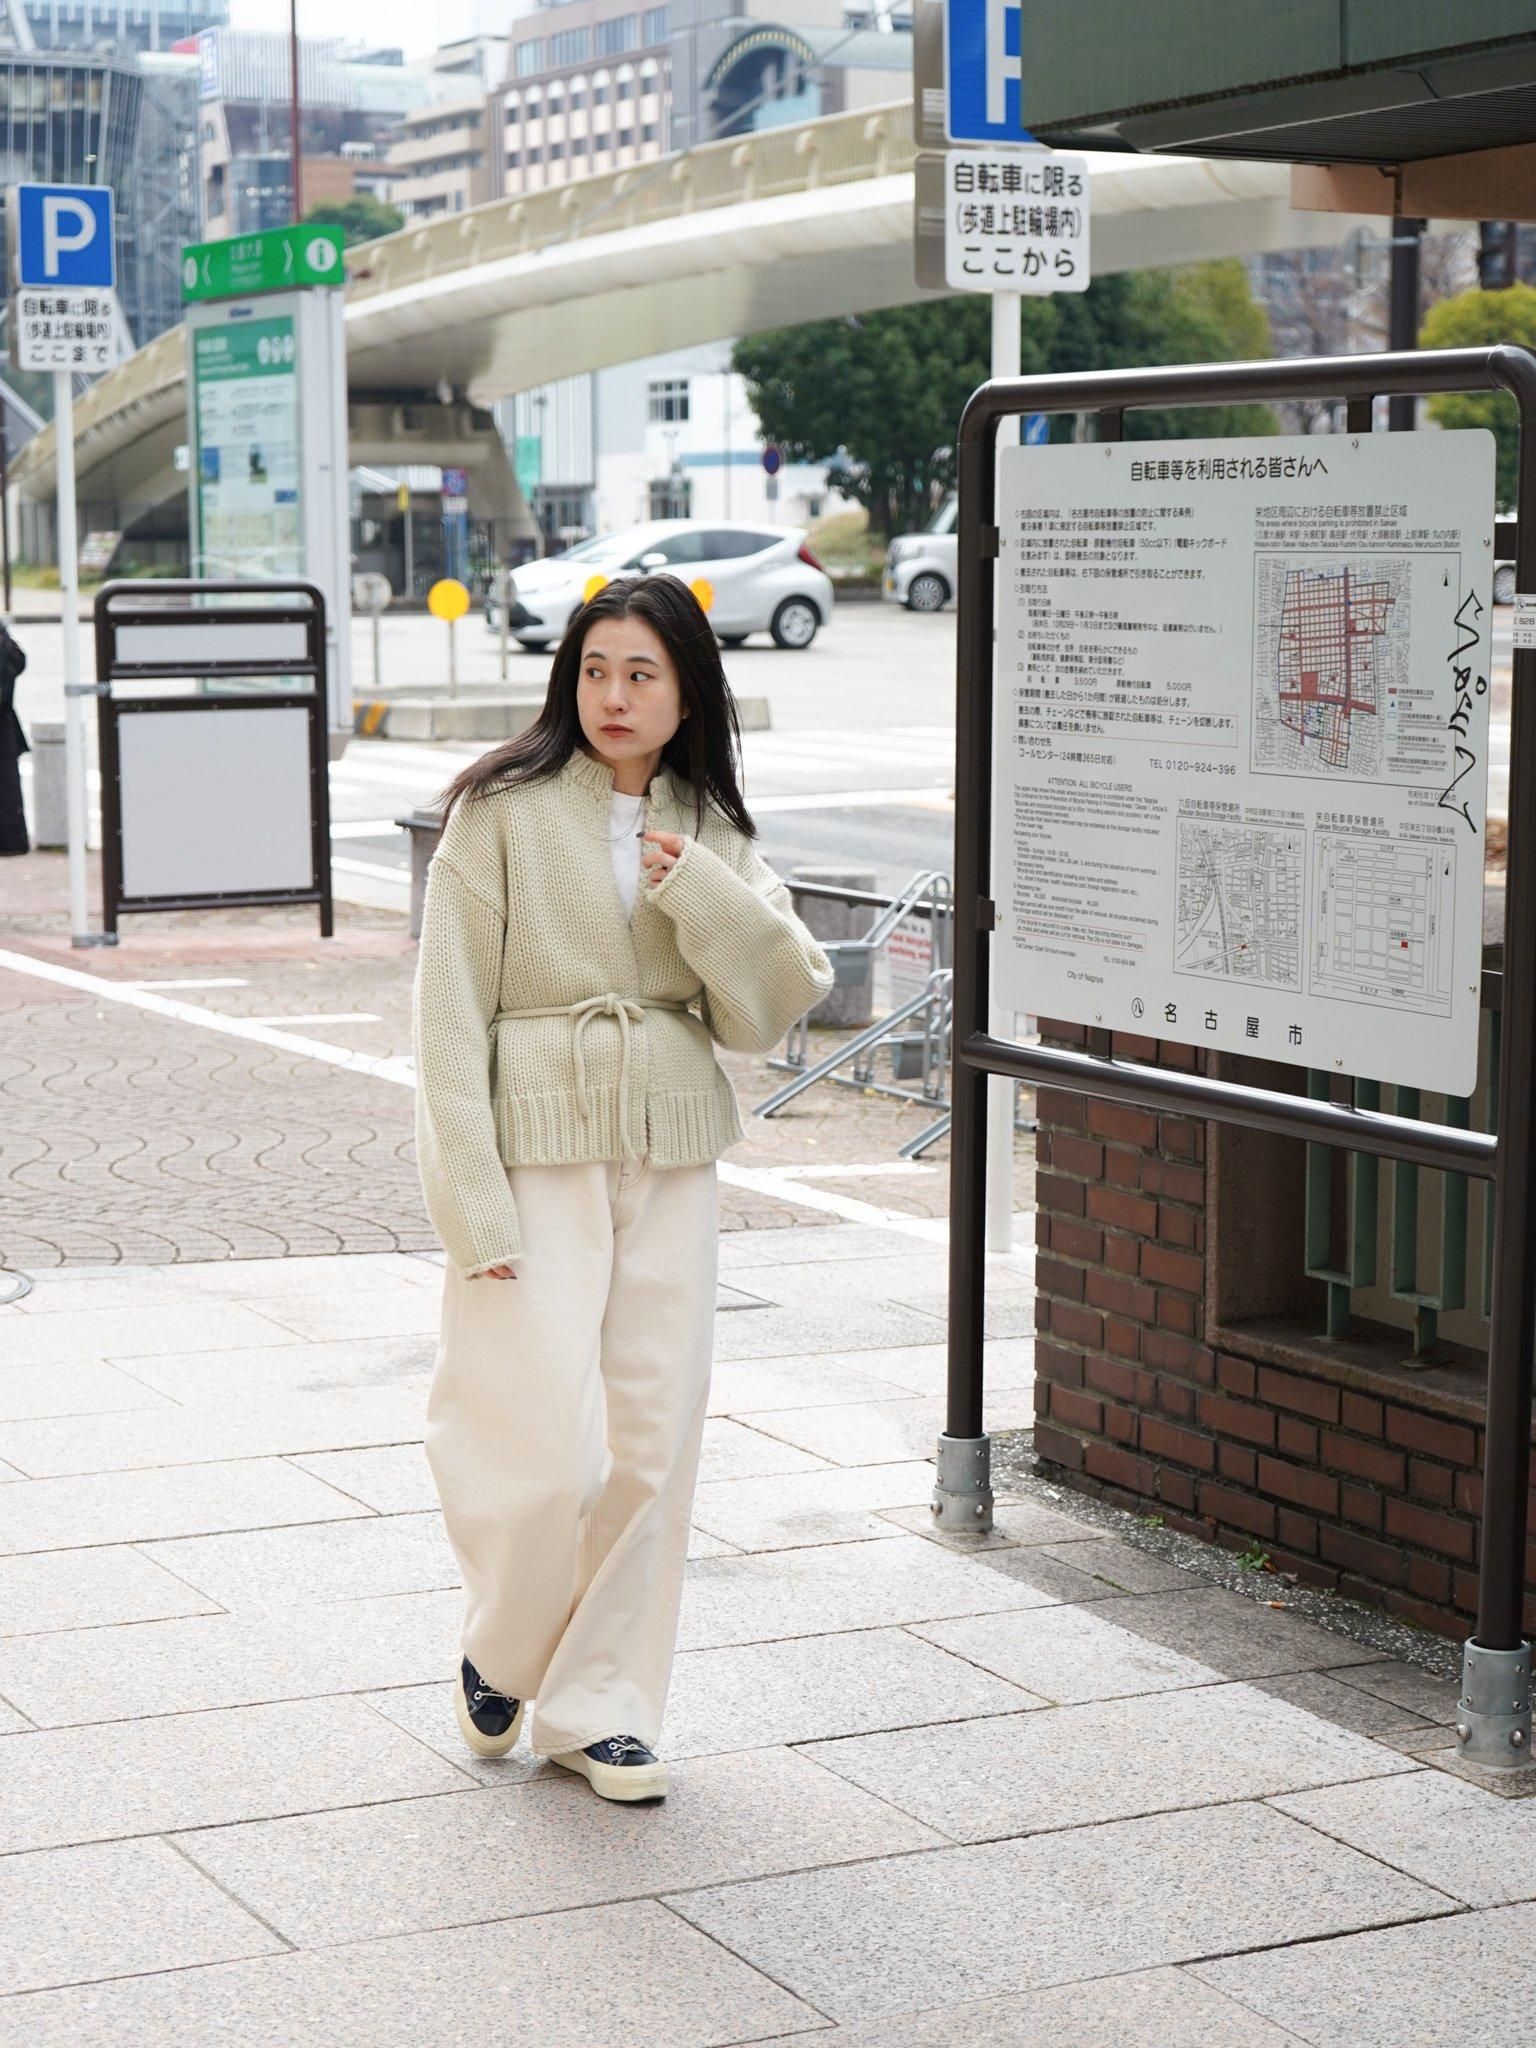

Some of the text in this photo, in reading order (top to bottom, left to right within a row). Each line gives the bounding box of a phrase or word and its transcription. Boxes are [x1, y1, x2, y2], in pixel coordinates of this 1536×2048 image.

[954, 162, 1083, 197] 自転車に限る
[43, 195, 97, 277] P
[963, 246, 1075, 277] ここから
[24, 297, 112, 317] 自転車に限る
[30, 345, 109, 363] ここまで
[1131, 455, 1328, 481] 自転車等を利用される皆さんへ
[1150, 759, 1163, 769] TEL
[1166, 761, 1236, 775] 0120-924-396
